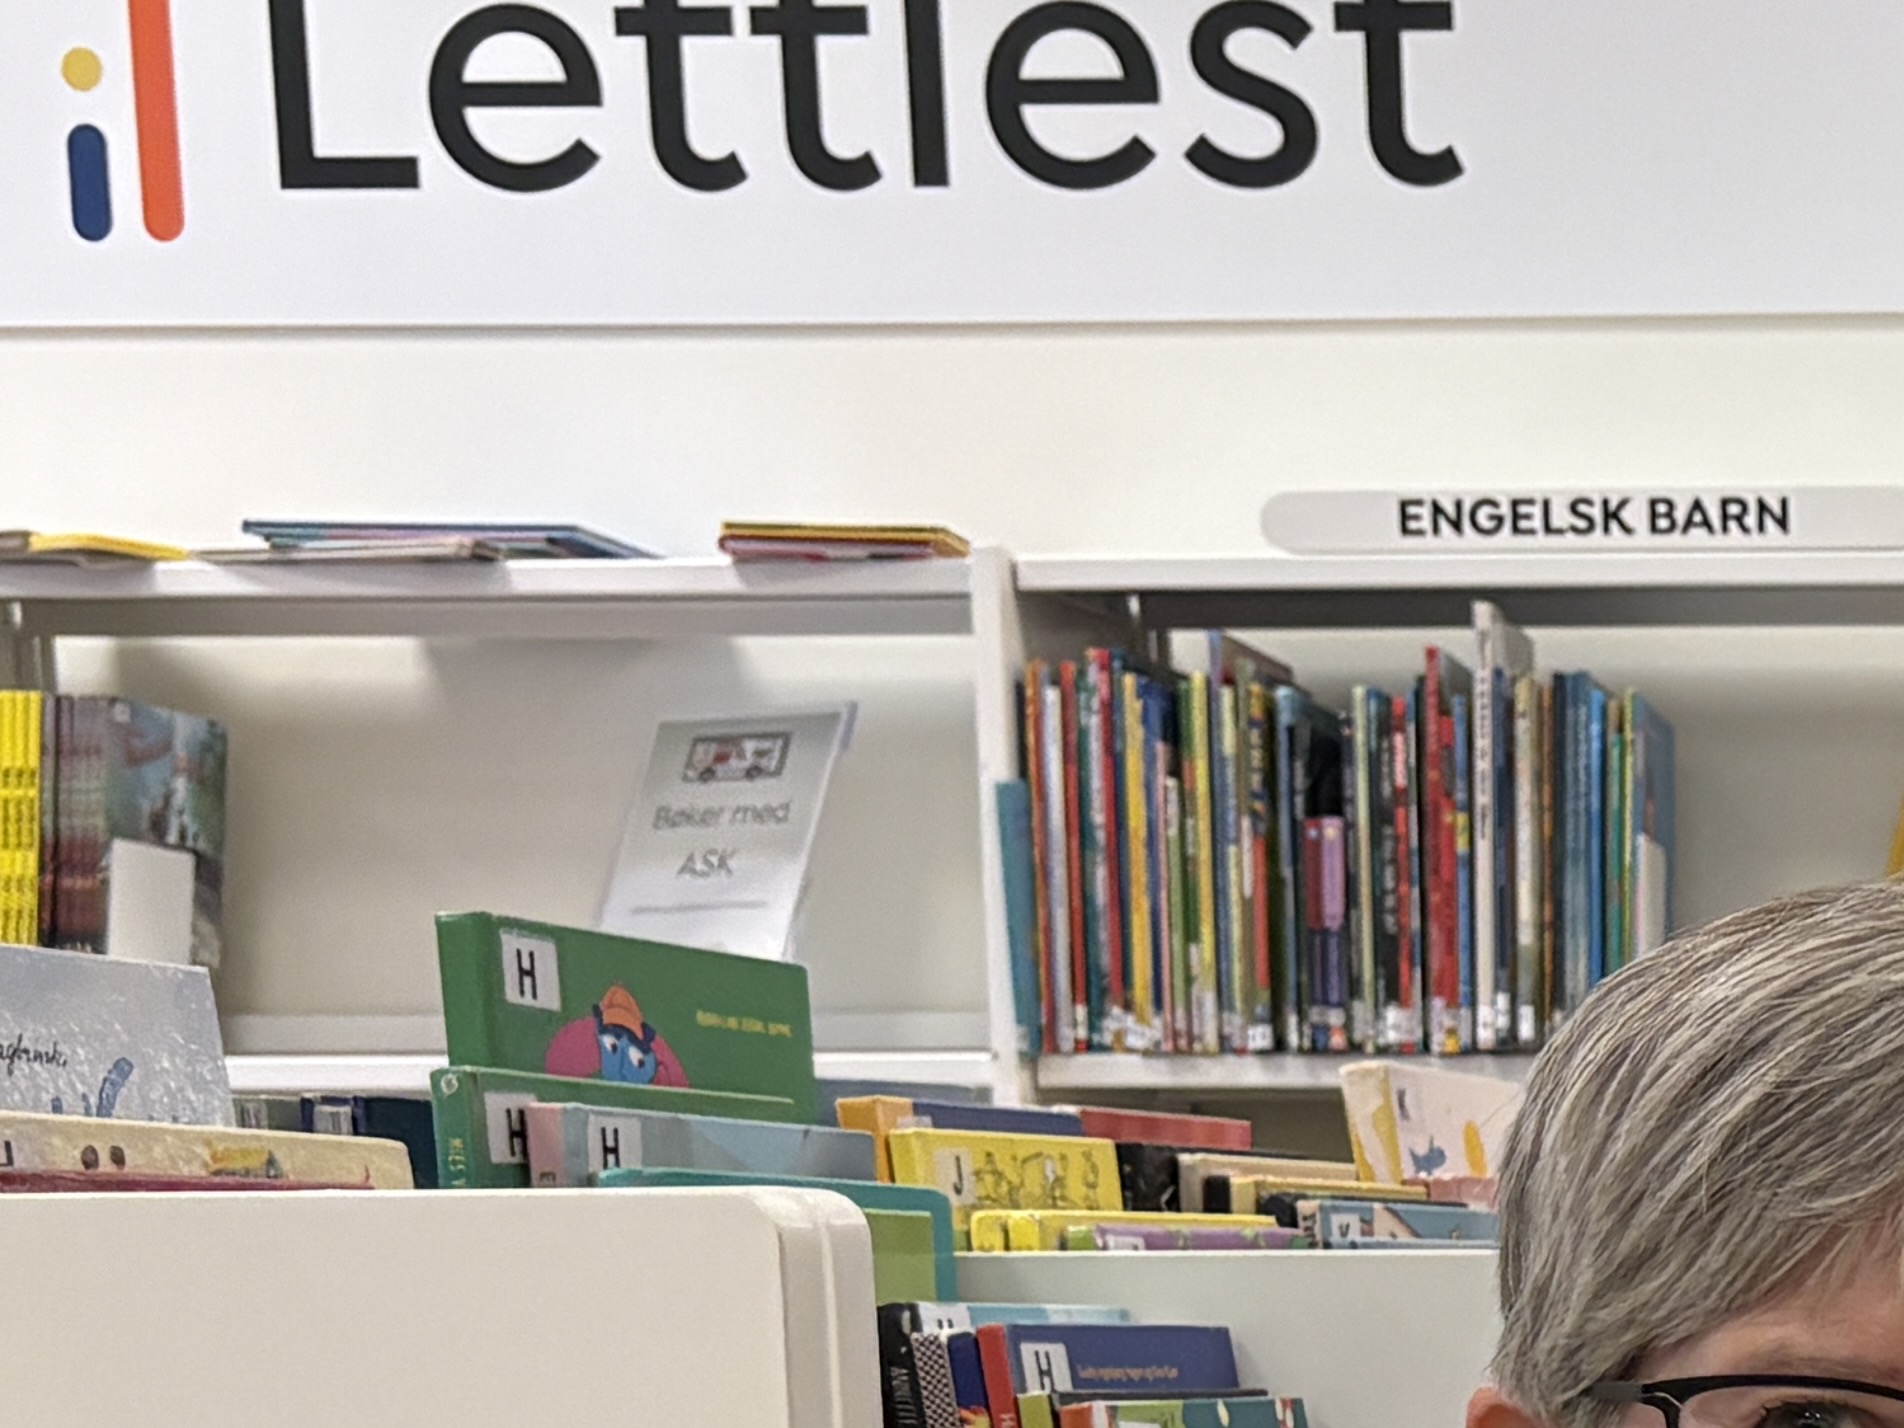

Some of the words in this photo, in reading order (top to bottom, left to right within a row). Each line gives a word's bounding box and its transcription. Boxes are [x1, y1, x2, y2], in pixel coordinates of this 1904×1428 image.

[266, 0, 1465, 194] Lettlest
[1398, 497, 1634, 539] ENGELSK
[1648, 495, 1791, 537] BARN
[516, 950, 538, 1000] H
[601, 1126, 621, 1170] H
[953, 1154, 964, 1196] J
